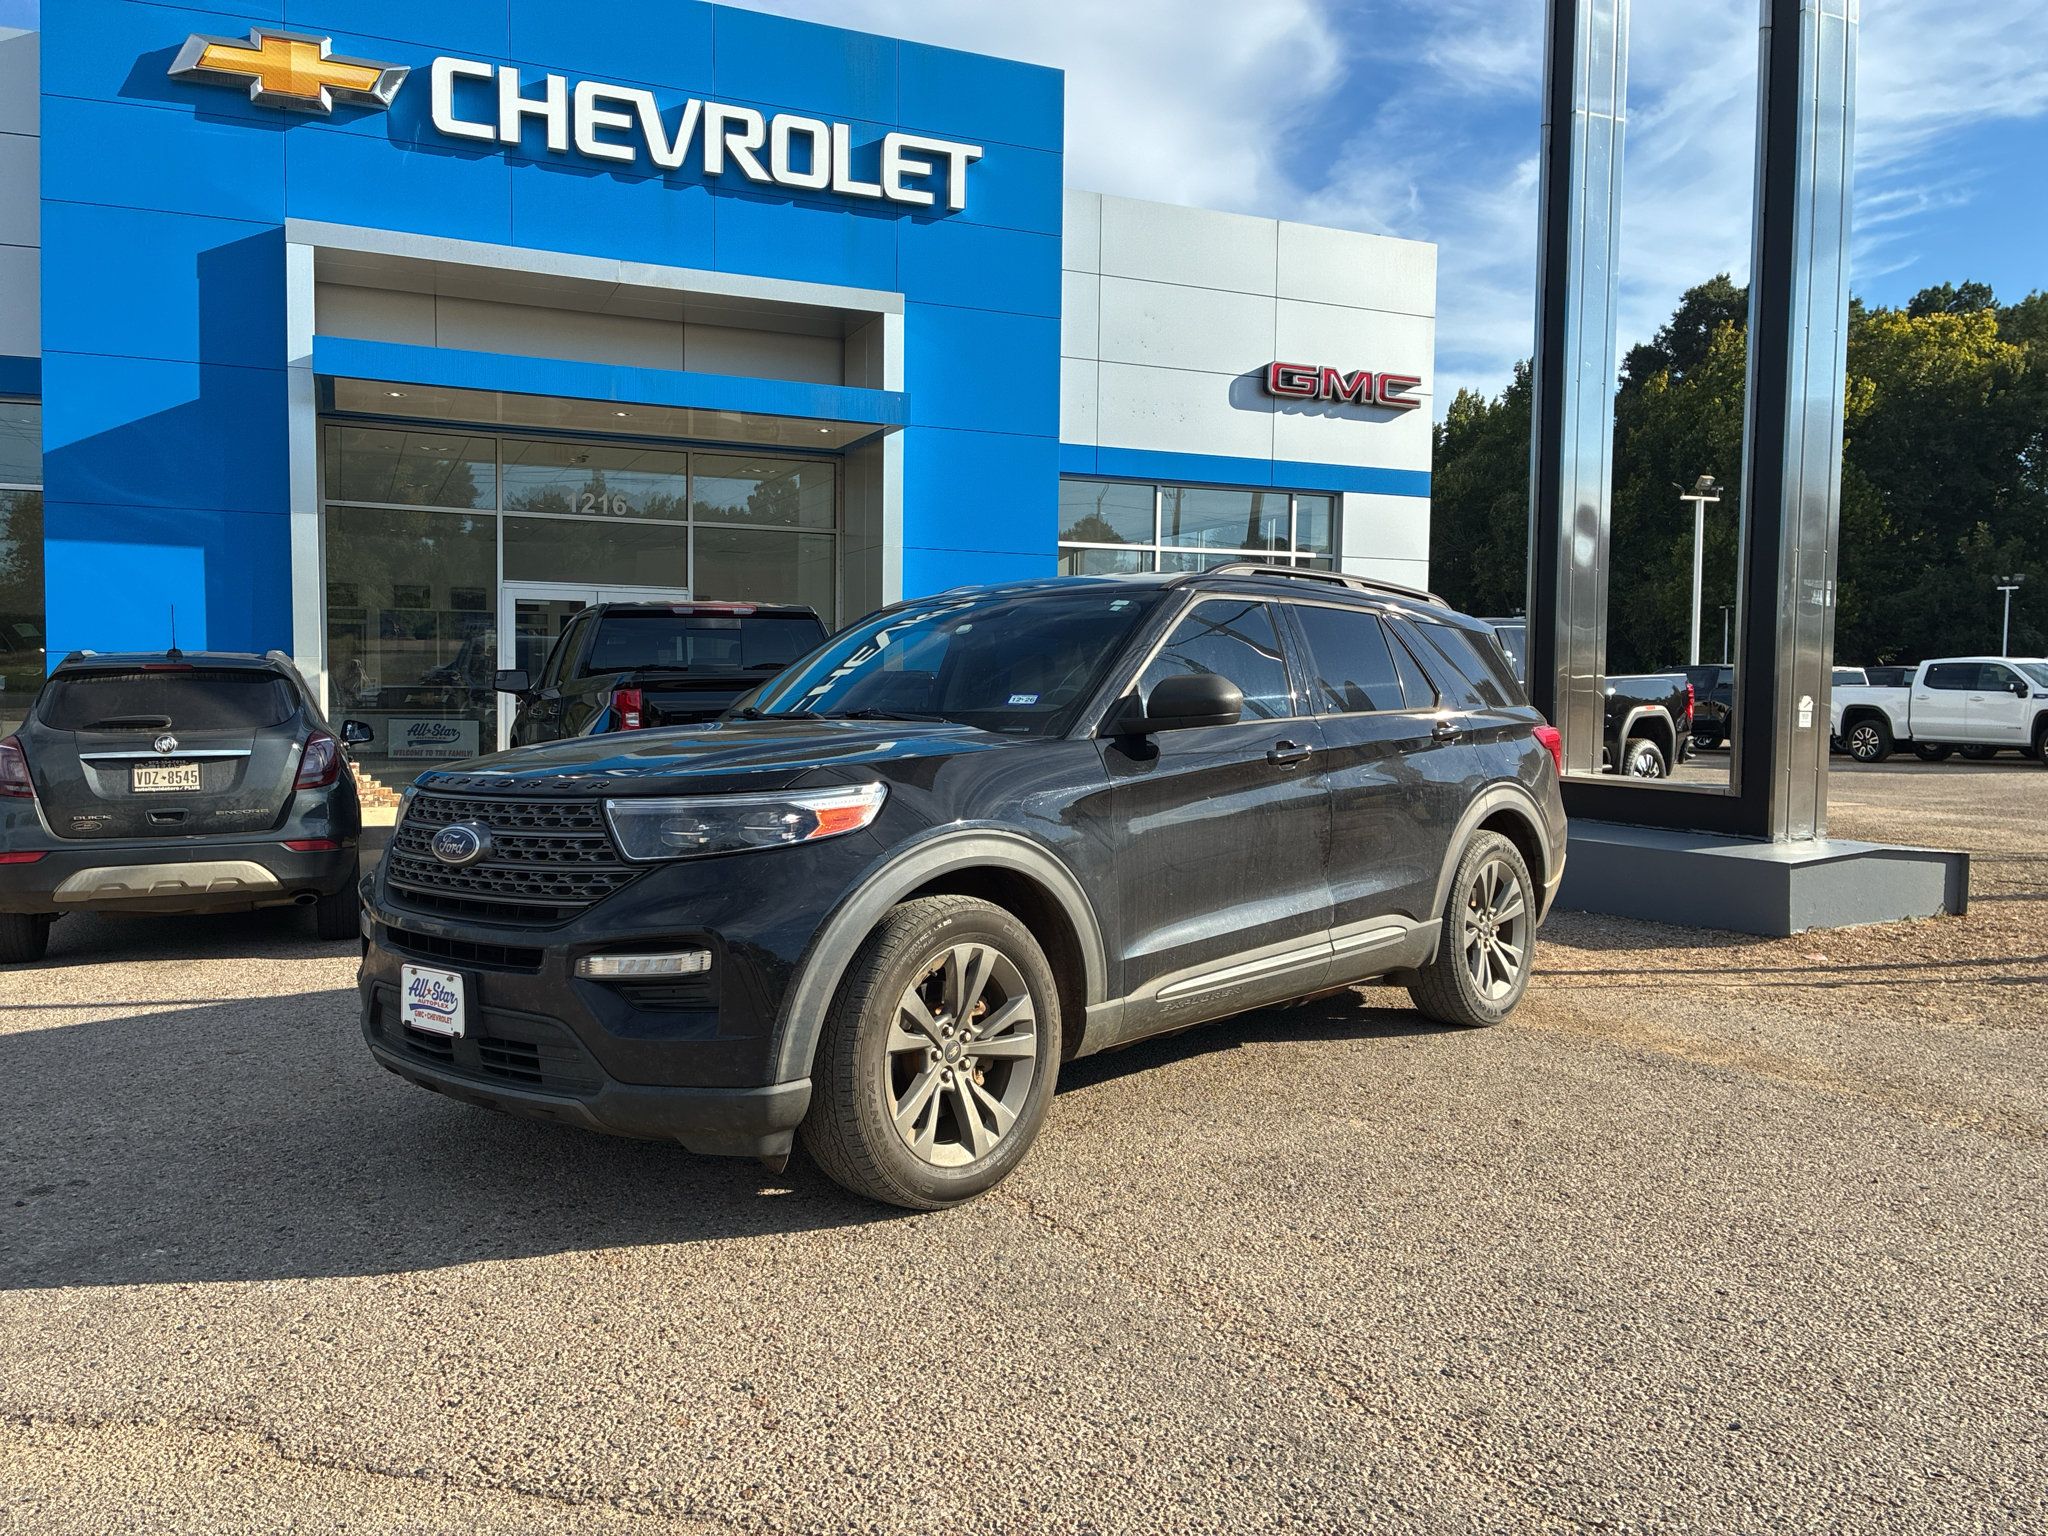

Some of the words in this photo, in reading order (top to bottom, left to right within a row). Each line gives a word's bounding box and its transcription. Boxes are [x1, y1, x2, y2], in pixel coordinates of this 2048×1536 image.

[431, 56, 984, 211] CHEVROLET
[1264, 361, 1422, 409] GMC
[566, 492, 627, 516] 1216
[393, 749, 423, 757] WELCOME
[428, 775, 610, 790] EXPLORER
[215, 808, 269, 816] ENCORE
[439, 832, 467, 855] Ford
[408, 977, 430, 999] All
[431, 980, 458, 1005] Star
[417, 999, 449, 1010] AUTOPLEX
[415, 1010, 425, 1019] GMC
[426, 1012, 453, 1025] CHEVROLET
